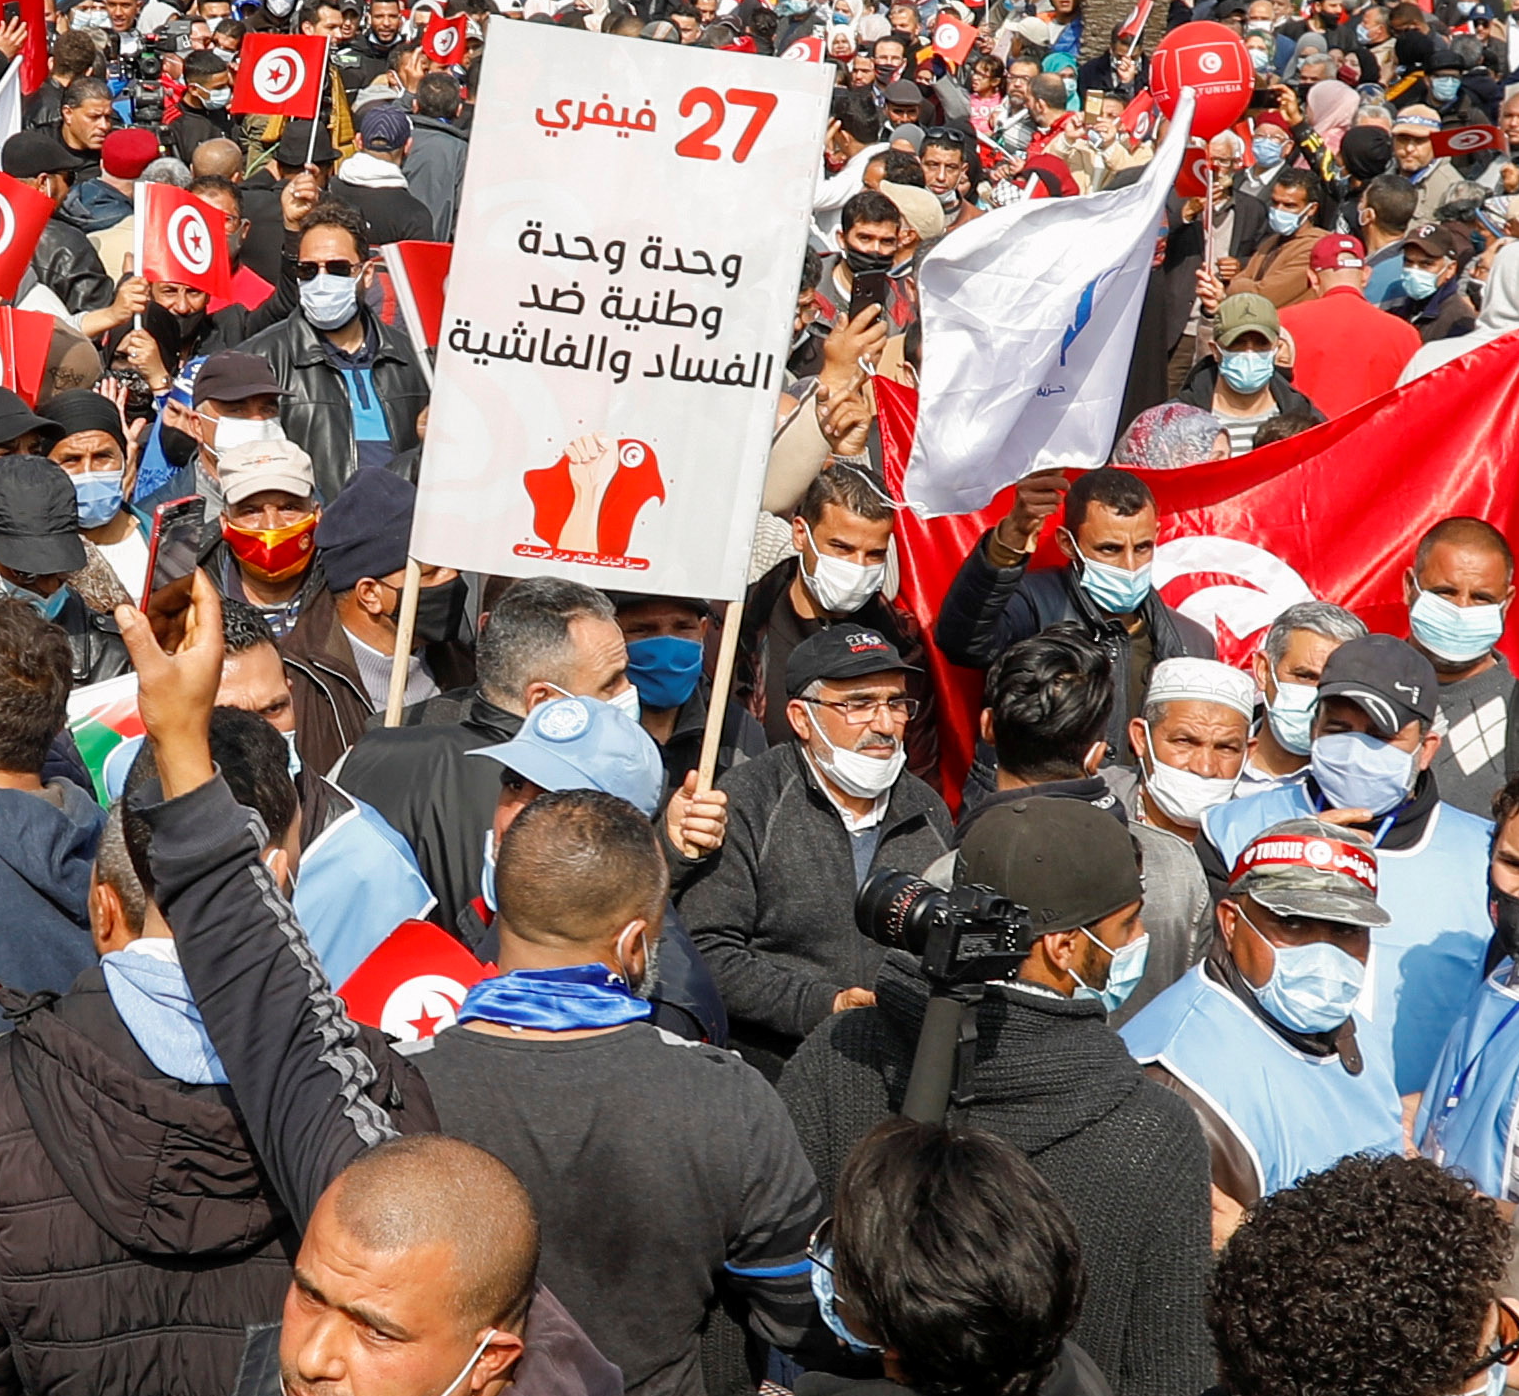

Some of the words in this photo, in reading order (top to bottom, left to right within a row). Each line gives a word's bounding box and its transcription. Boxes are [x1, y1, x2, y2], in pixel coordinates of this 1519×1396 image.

[1197, 84, 1242, 96] TUNISIA
[536, 94, 656, 138] فيفري
[676, 87, 778, 163] 27
[519, 221, 626, 275] وحدة
[641, 236, 742, 289] وحدة
[520, 282, 585, 315] ضد
[601, 286, 723, 341] وطنية
[449, 319, 632, 384] والفاشية
[643, 345, 774, 390] الفساد
[1256, 841, 1304, 860] TUNISIE
